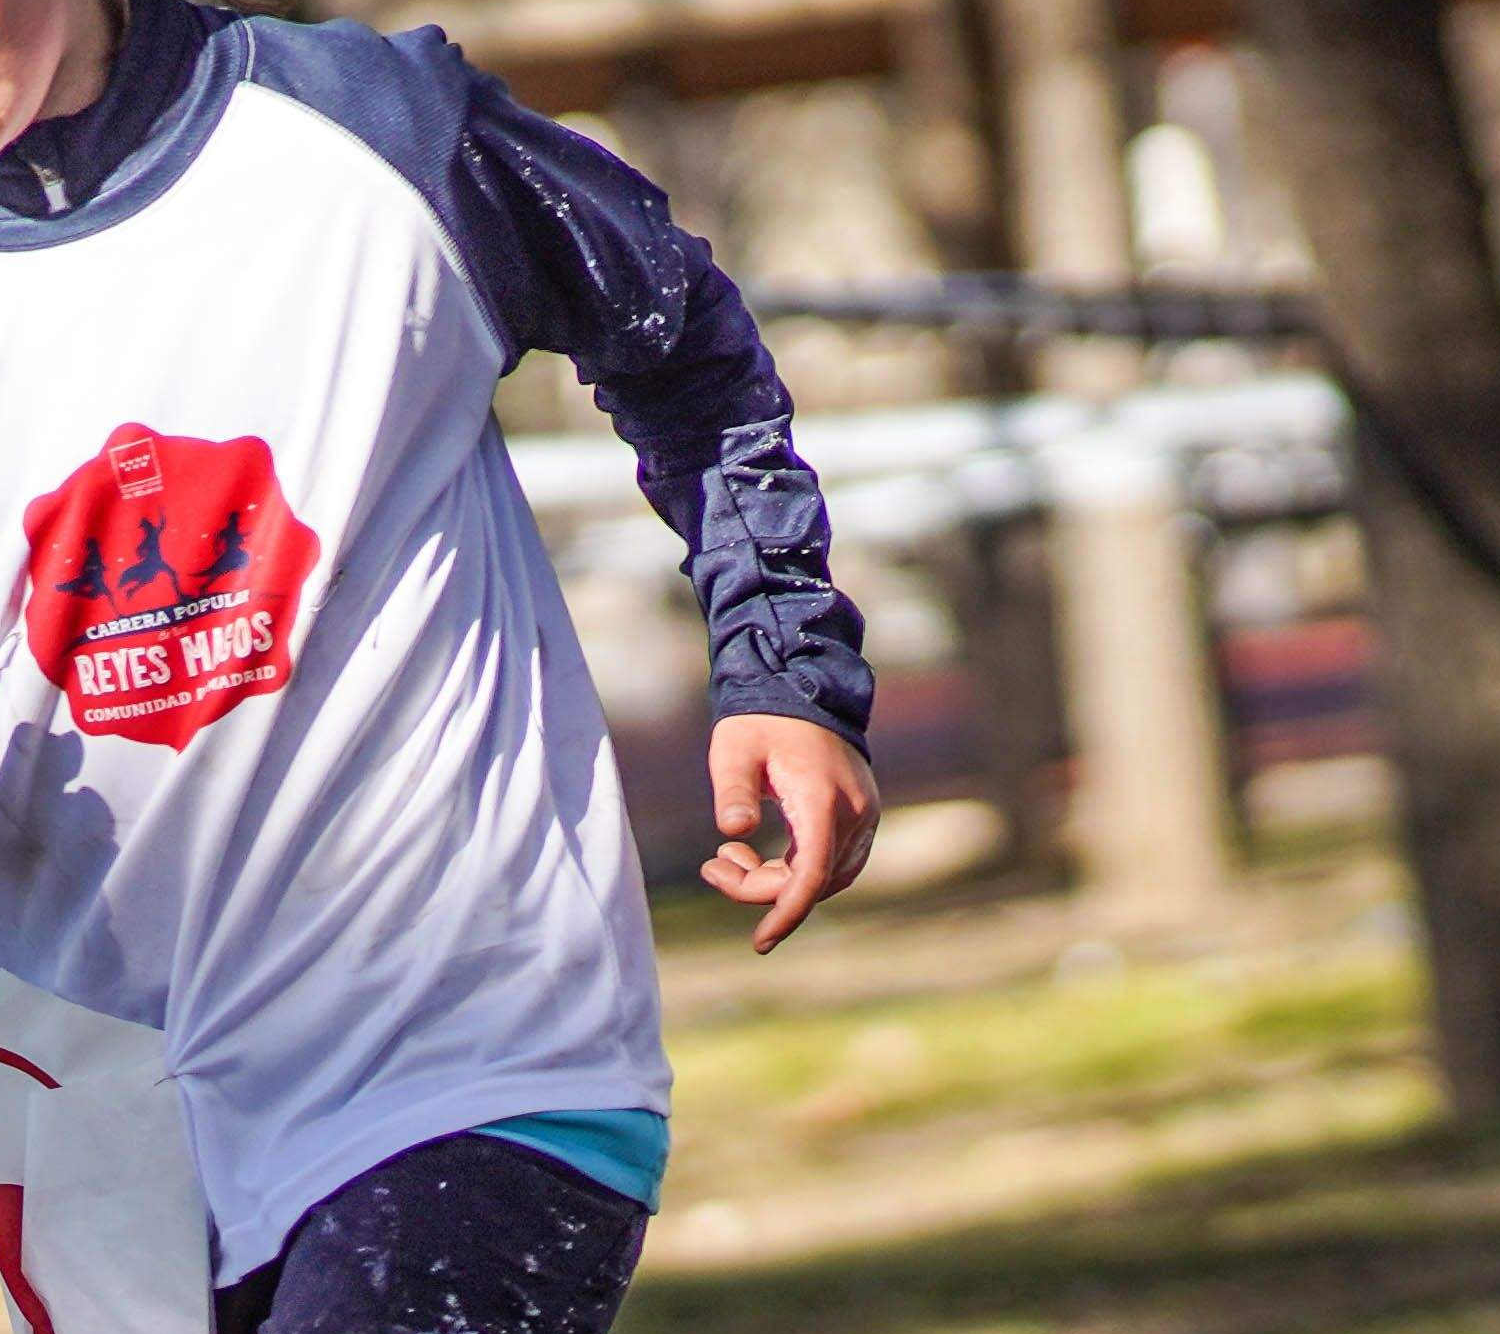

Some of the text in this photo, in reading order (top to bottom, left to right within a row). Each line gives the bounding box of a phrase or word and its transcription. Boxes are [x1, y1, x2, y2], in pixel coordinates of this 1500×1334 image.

[85, 610, 171, 640] CARRERA
[173, 589, 250, 620] POPUL
[74, 645, 171, 696] REYES
[84, 691, 193, 723] COMUNIDAD
